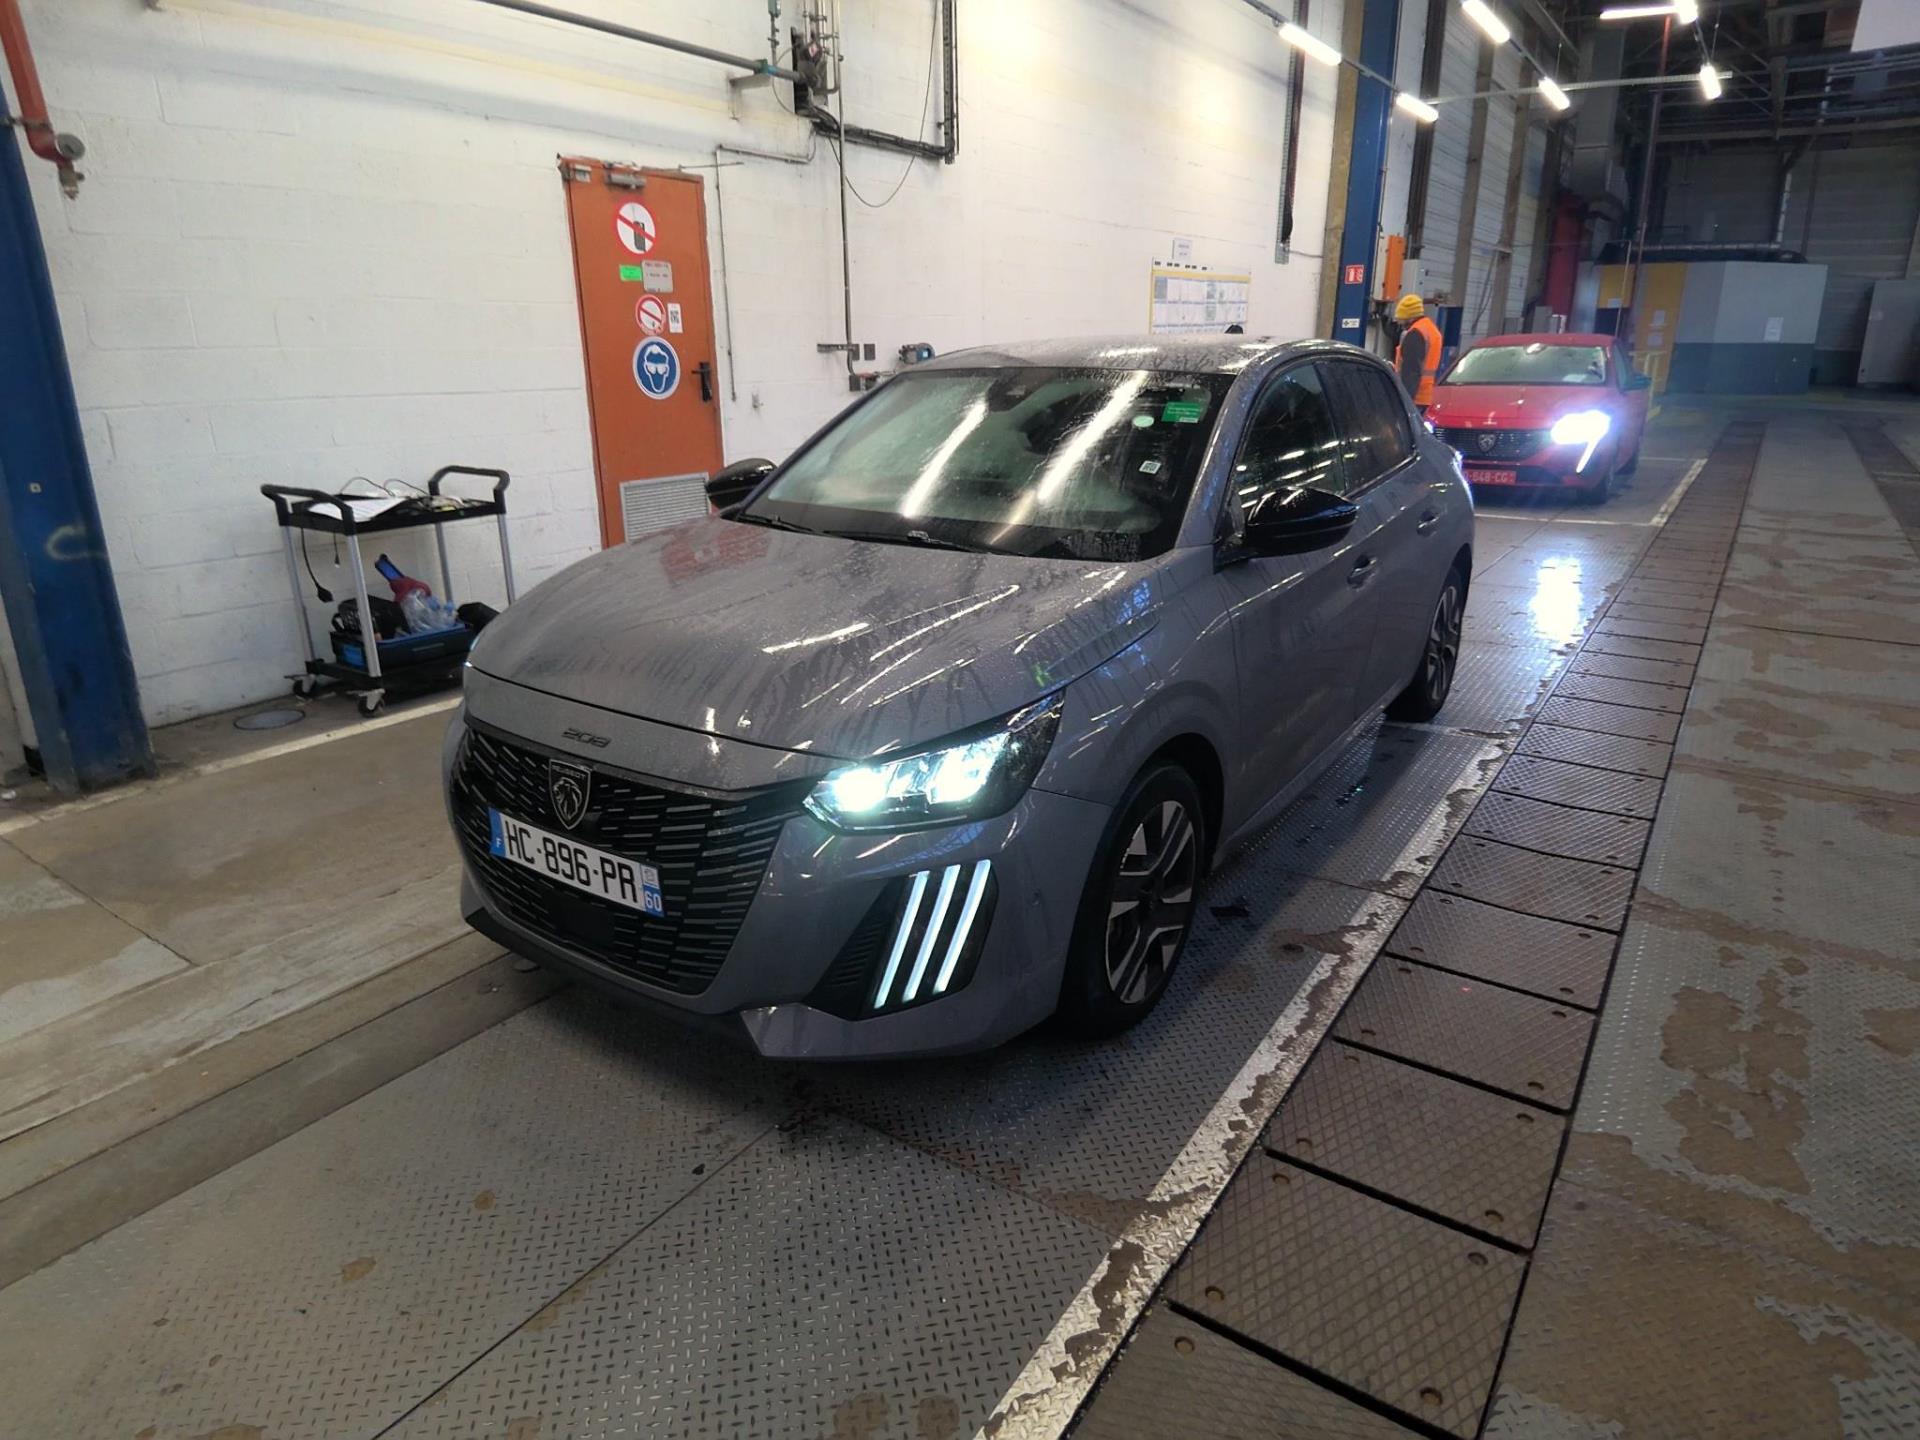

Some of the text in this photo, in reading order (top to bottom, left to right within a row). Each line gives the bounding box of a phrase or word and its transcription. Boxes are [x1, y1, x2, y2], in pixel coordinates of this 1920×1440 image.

[562, 727, 612, 748] 208
[505, 820, 639, 904] HC-896-PR
[645, 890, 662, 912] 60
